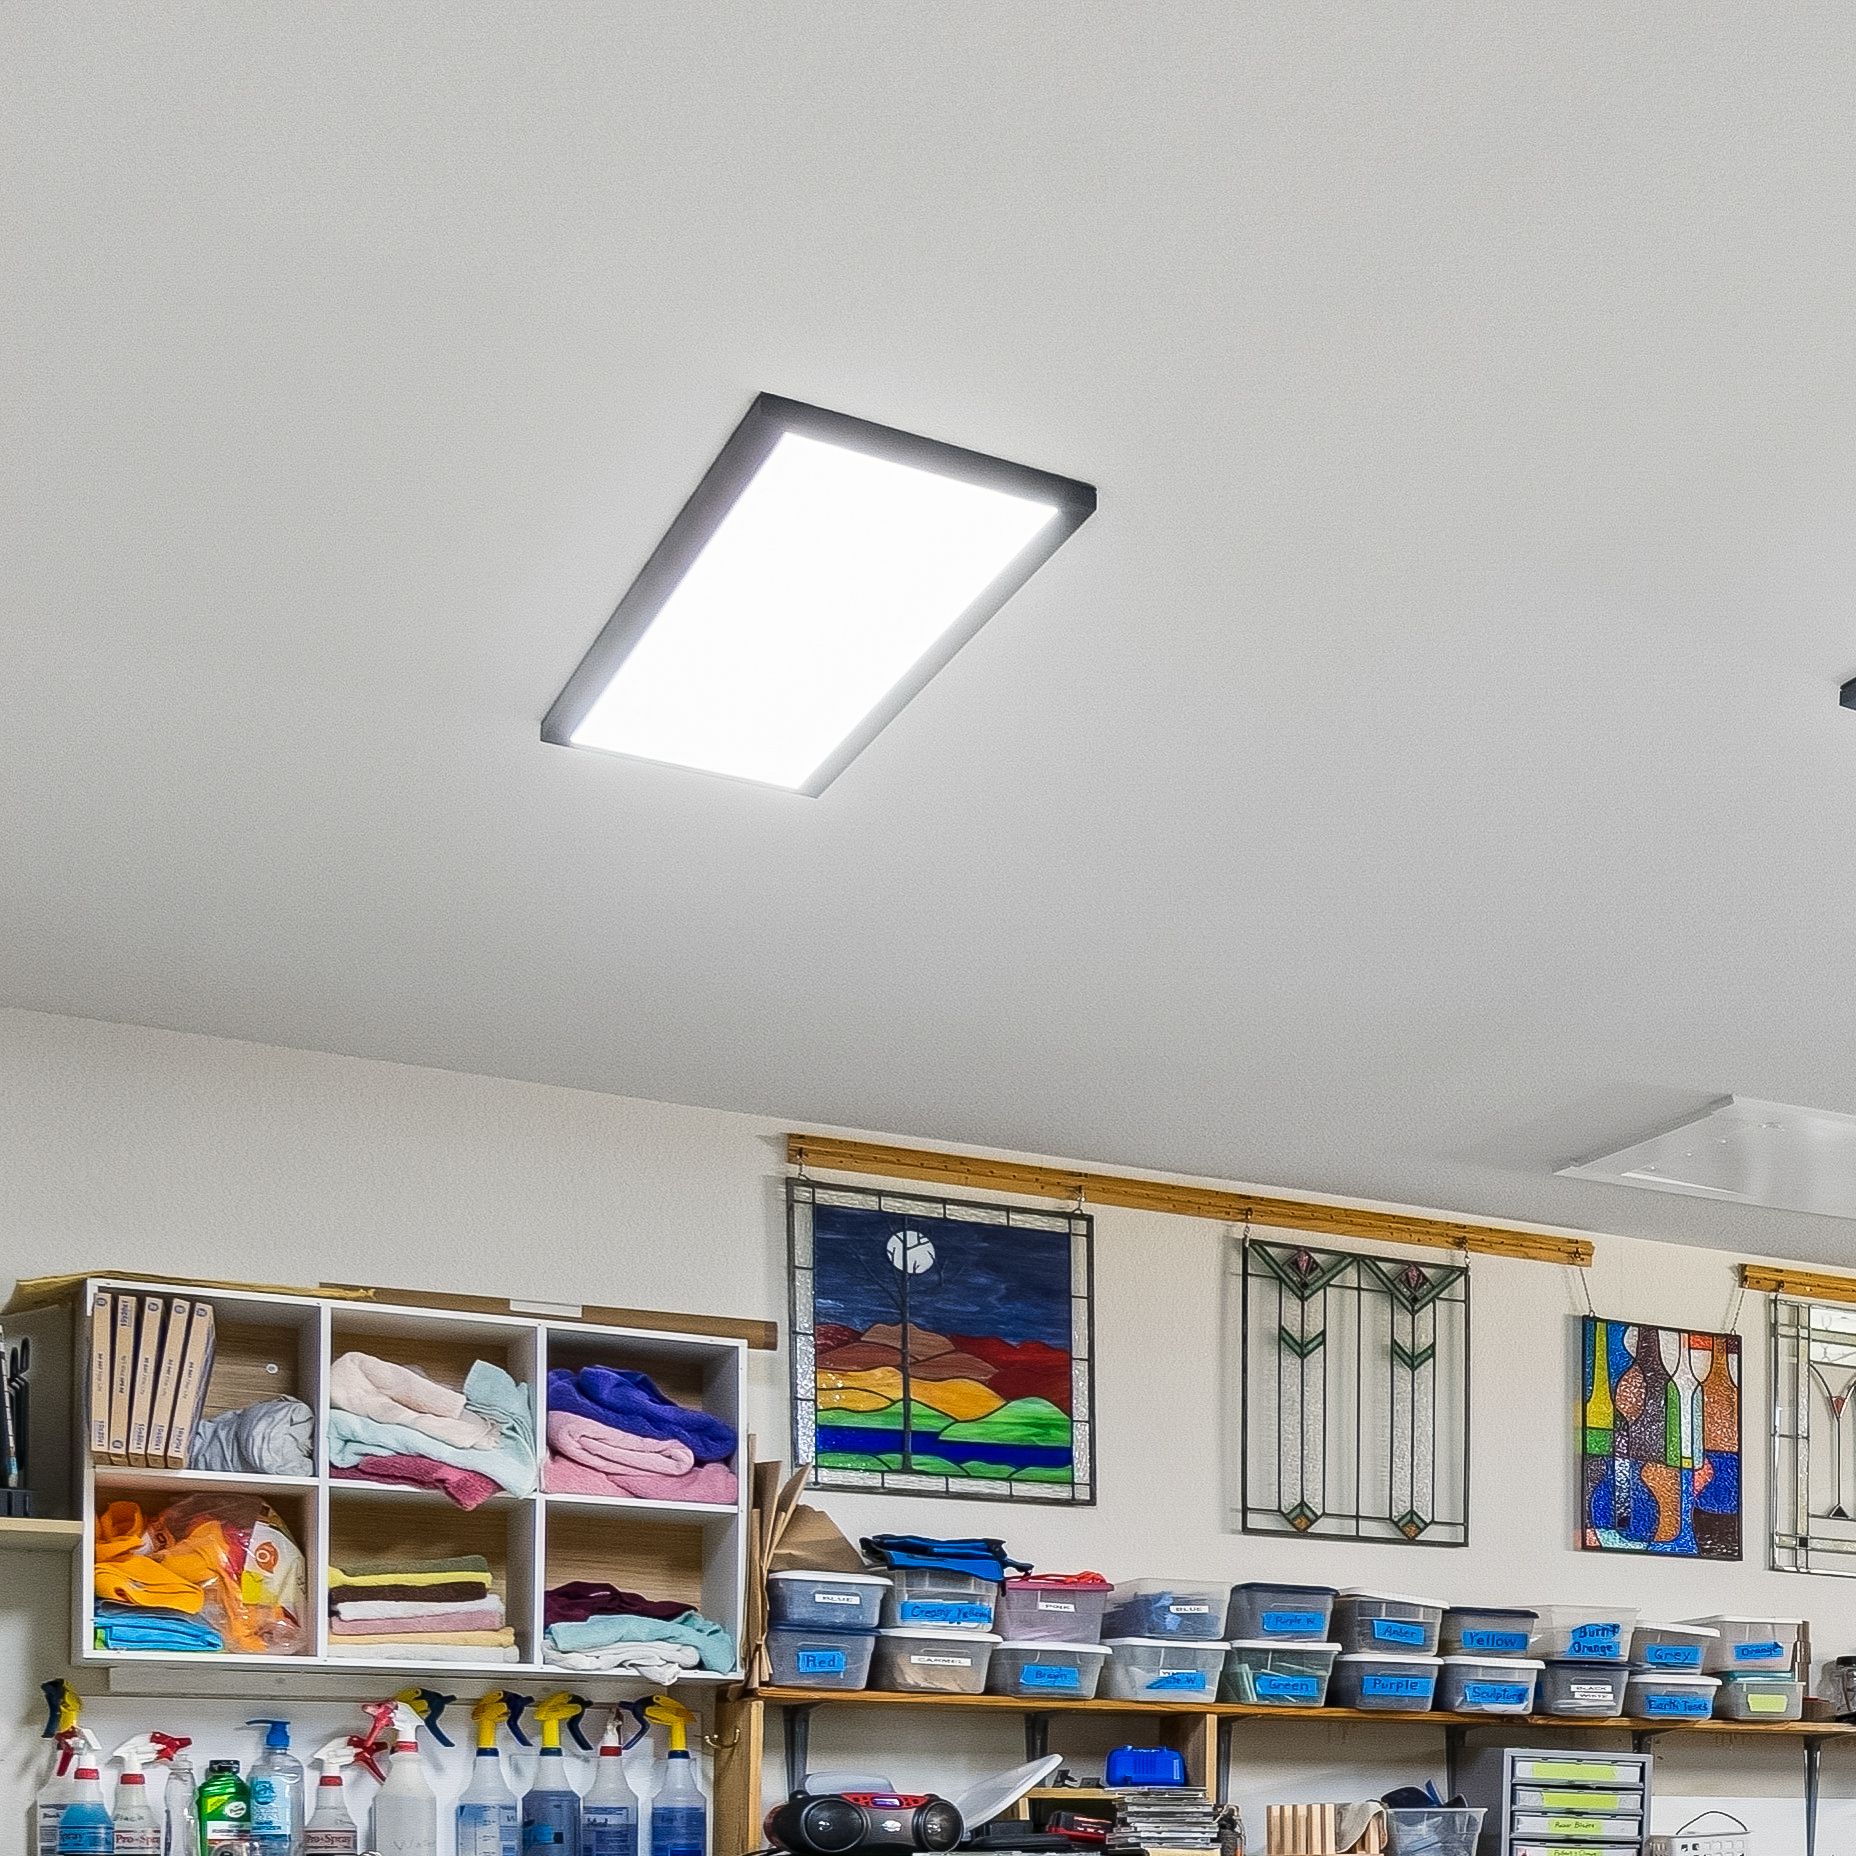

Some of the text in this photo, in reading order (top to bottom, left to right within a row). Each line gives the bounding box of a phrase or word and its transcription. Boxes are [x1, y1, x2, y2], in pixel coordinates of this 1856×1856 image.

[1578, 1624, 1621, 1639] Burnt
[1469, 1632, 1518, 1647] Yellow
[1572, 1641, 1614, 1656] Orange
[1654, 1649, 1691, 1661] Grey
[805, 1655, 836, 1668] Red
[1269, 1680, 1309, 1691] Green
[1373, 1678, 1419, 1692] Purple
[1472, 1686, 1526, 1701] Sculpture
[1649, 1698, 1678, 1710] Earth
